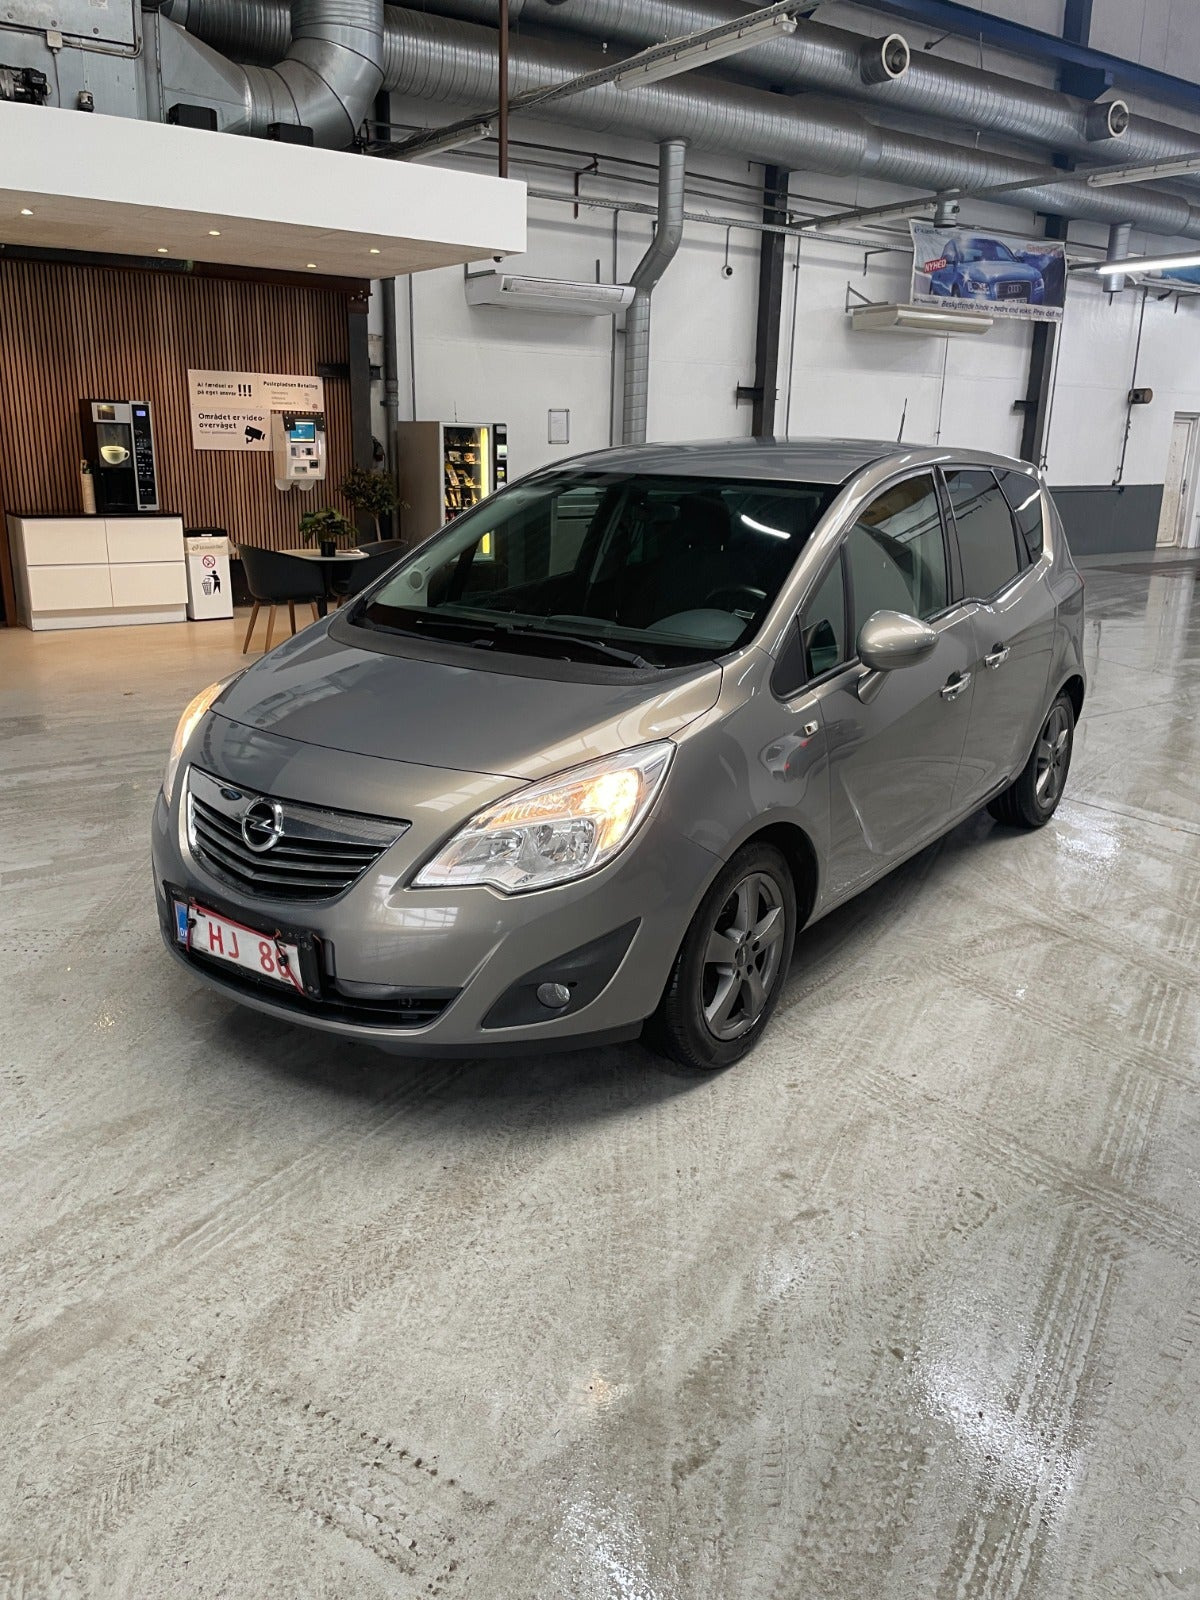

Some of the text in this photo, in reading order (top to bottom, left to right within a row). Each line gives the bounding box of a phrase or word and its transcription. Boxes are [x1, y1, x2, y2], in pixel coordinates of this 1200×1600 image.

[925, 260, 947, 272] NYHED
[297, 382, 318, 390] Betaling
[198, 412, 231, 421] Området
[199, 422, 237, 430] overvåget
[209, 921, 239, 959] HJ
